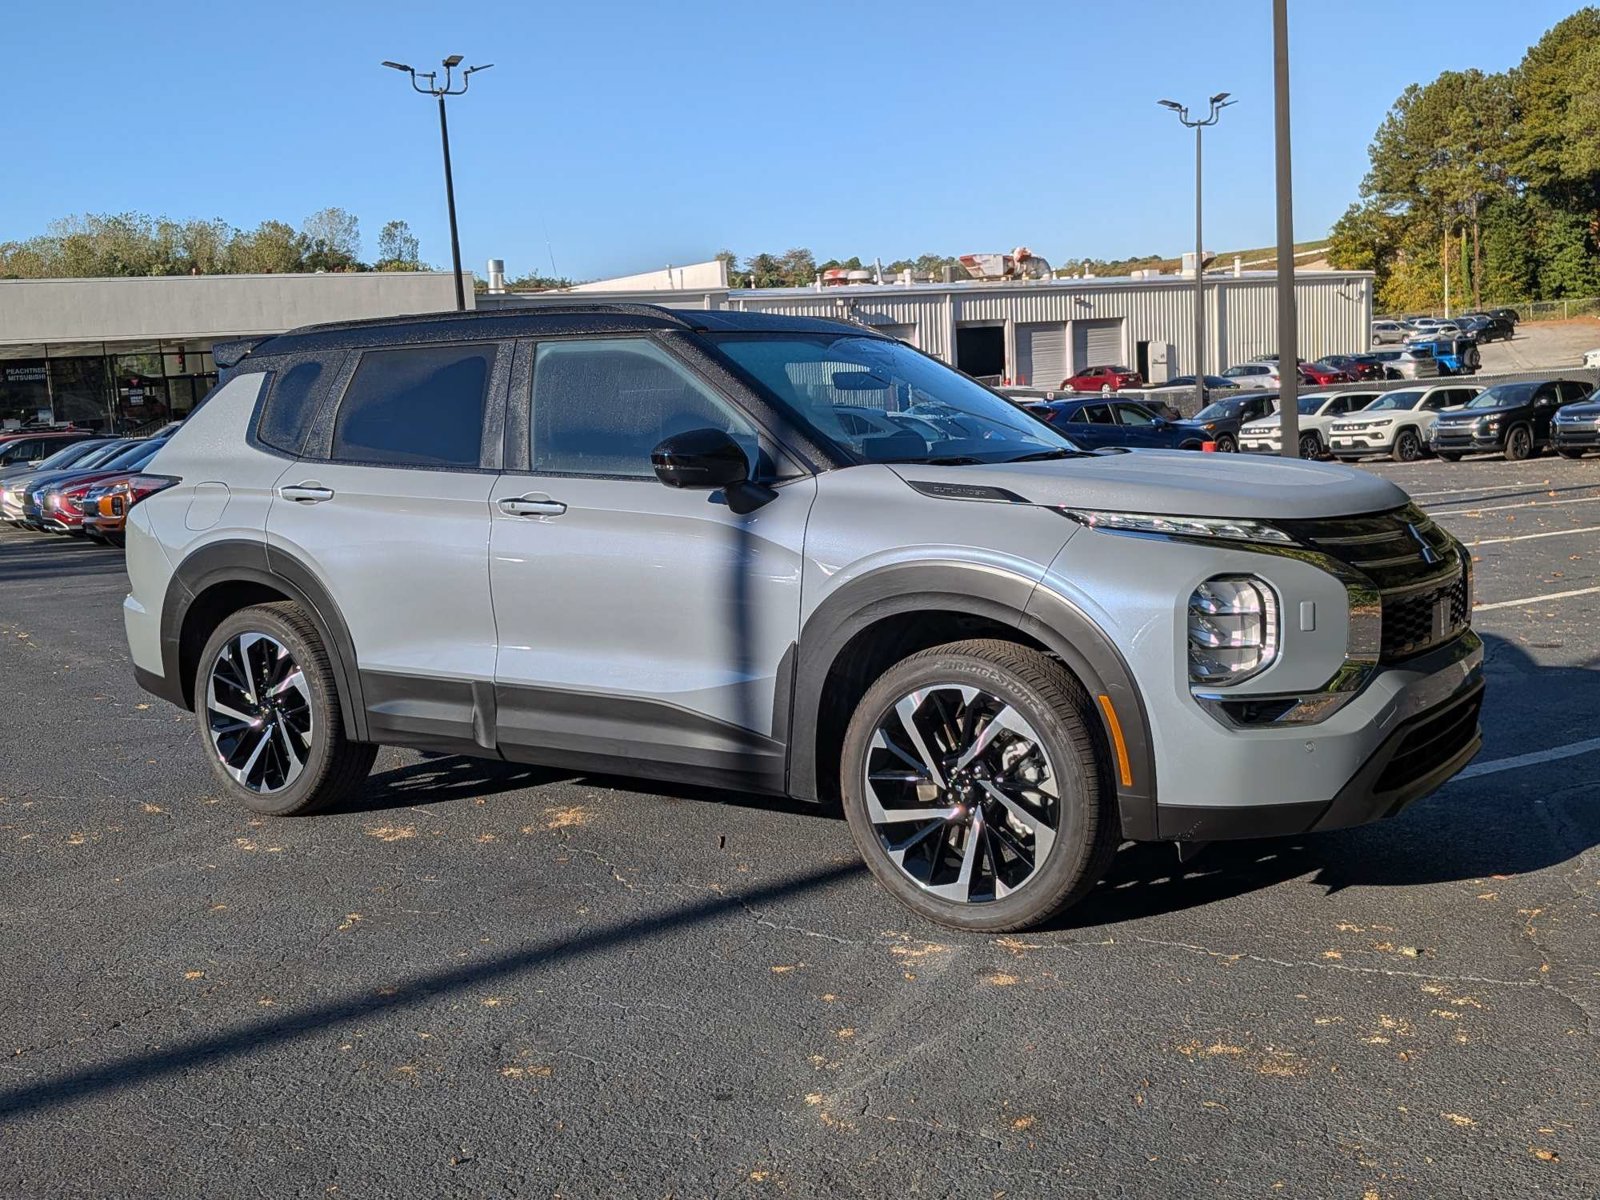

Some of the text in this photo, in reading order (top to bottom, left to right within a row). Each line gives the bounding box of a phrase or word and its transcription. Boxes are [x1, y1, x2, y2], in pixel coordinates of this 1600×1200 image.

[6, 367, 46, 375] PEACHTREE
[8, 373, 46, 381] MITSUBISHI
[933, 486, 986, 496] OUTLANDER
